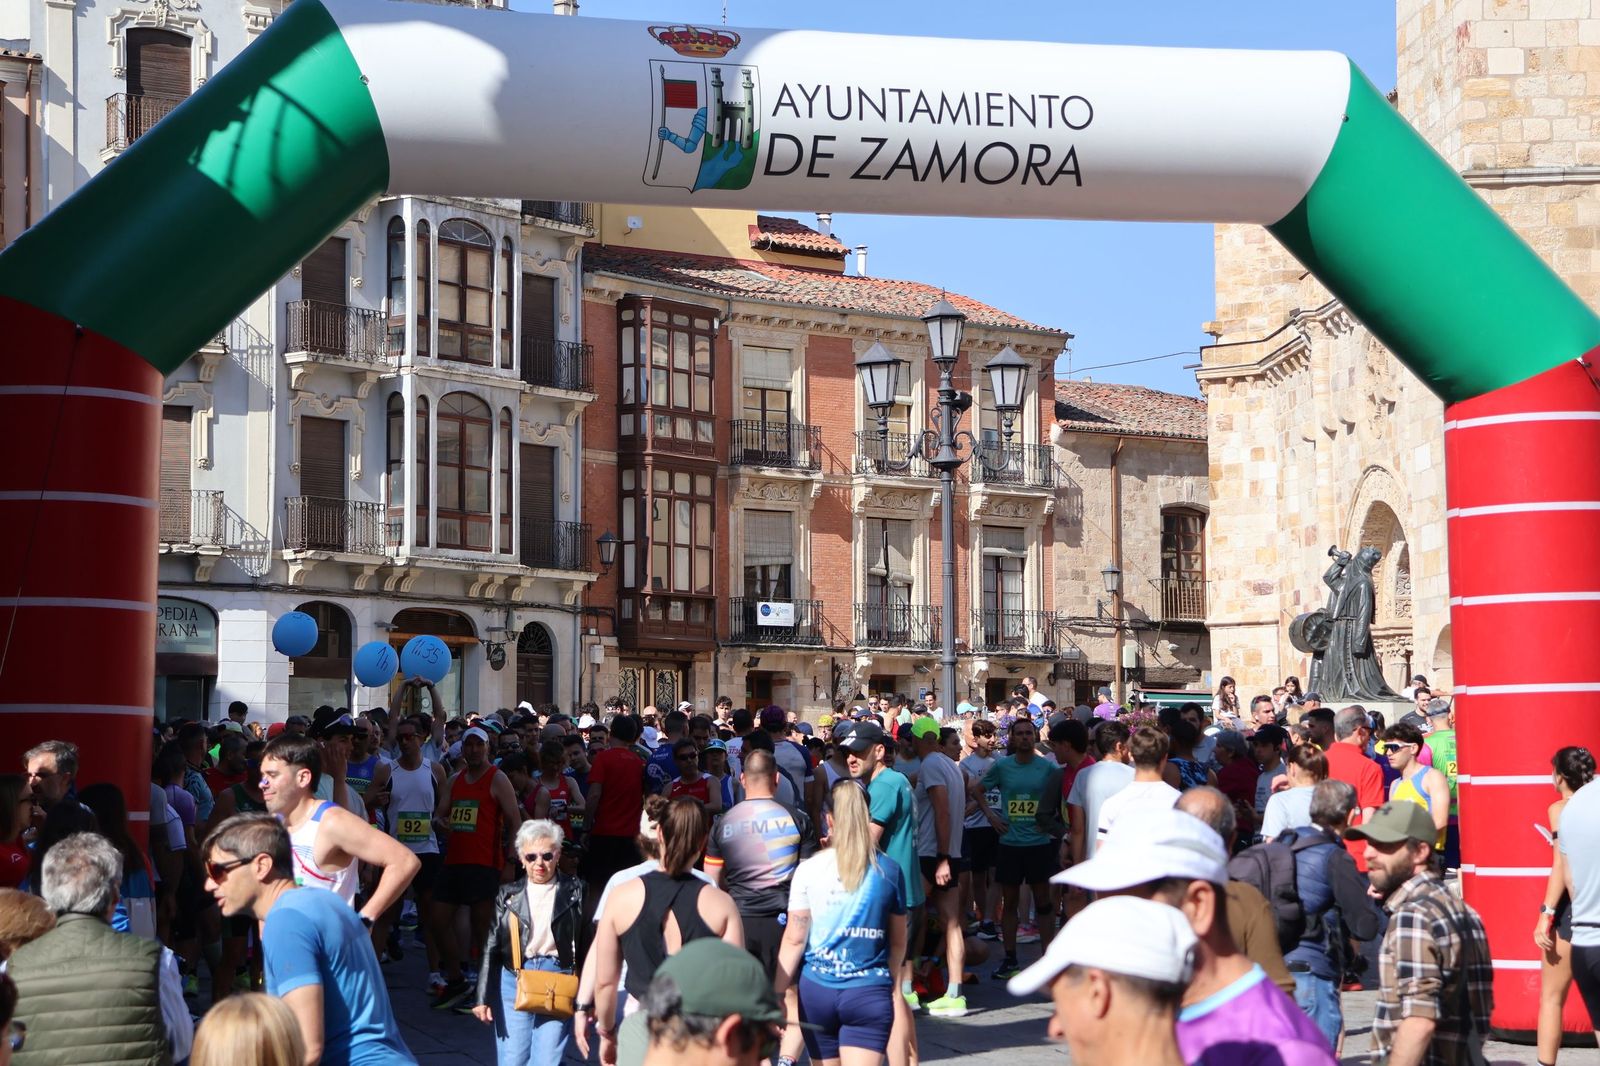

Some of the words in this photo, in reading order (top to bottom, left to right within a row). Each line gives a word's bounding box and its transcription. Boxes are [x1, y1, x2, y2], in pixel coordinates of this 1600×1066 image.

[772, 82, 1094, 131] AYUNTAMIENTO
[763, 133, 837, 179] DE
[850, 137, 1084, 187] ZAMORA
[1010, 801, 1034, 814] 242
[452, 808, 472, 822] 415
[404, 820, 421, 833] 92
